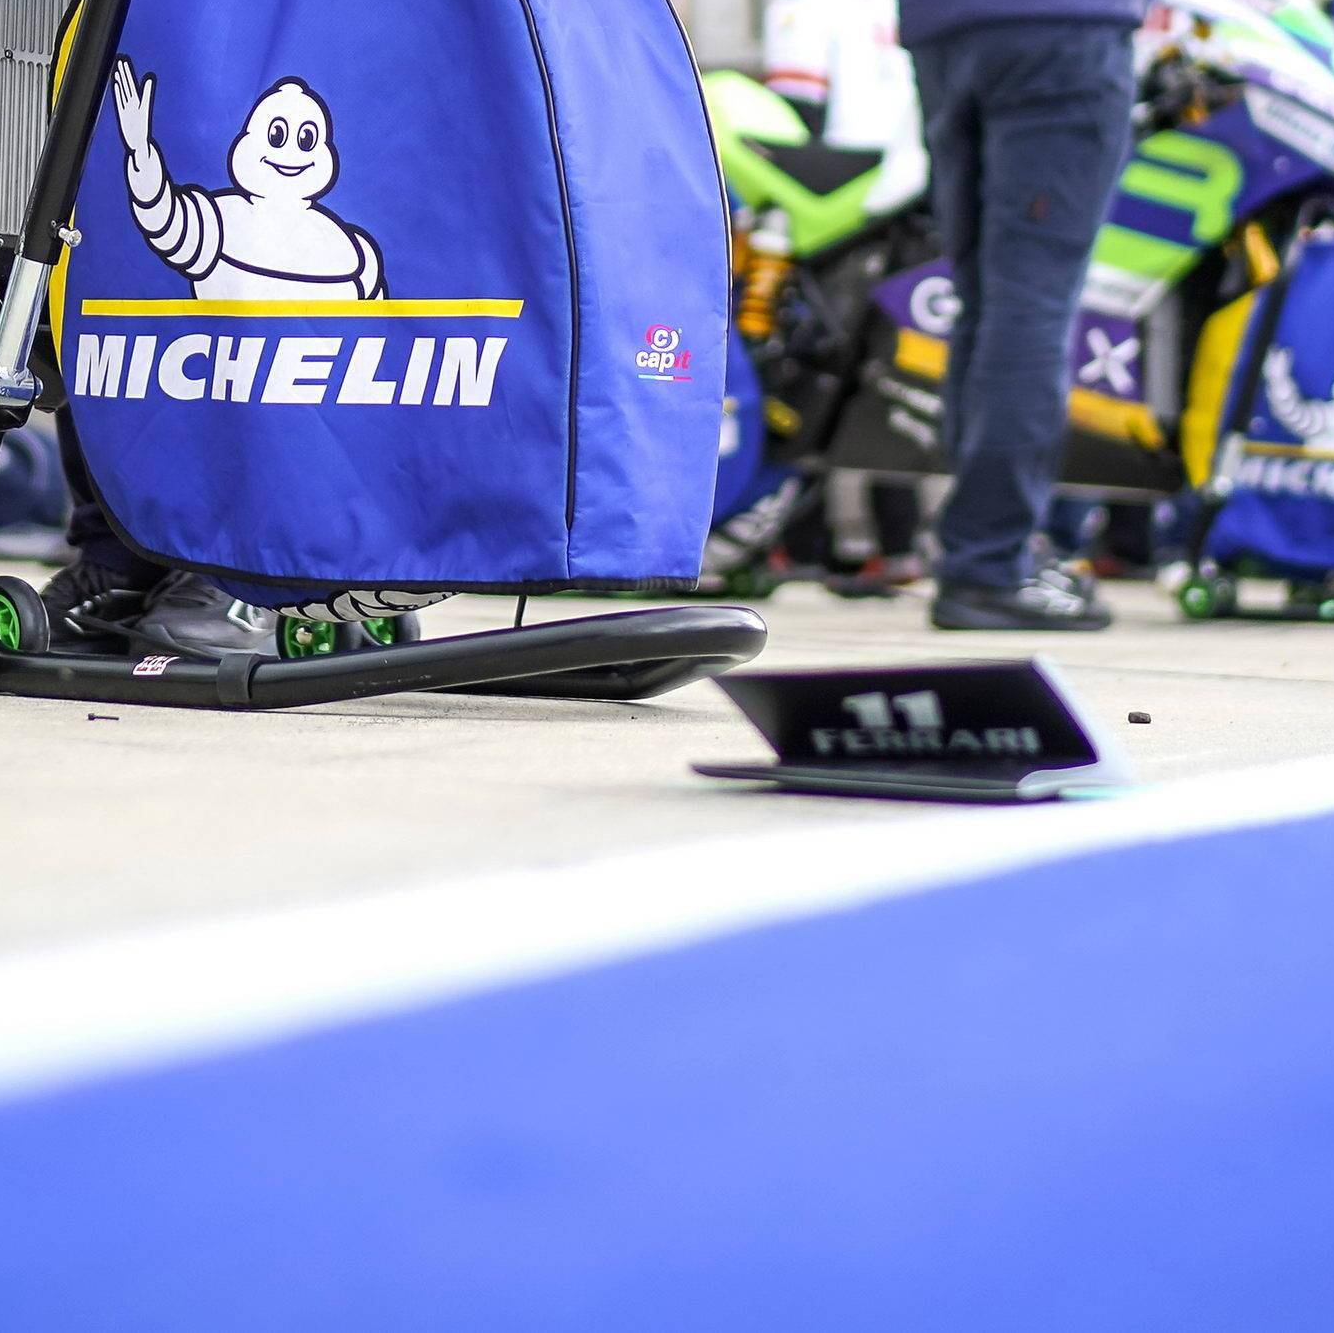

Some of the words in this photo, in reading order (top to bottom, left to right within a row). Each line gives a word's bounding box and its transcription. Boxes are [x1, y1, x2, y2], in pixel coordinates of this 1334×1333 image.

[64, 333, 509, 406] MICHELIN
[635, 350, 692, 373] capit
[841, 689, 942, 728] 11
[810, 727, 1043, 756] FERRARI
